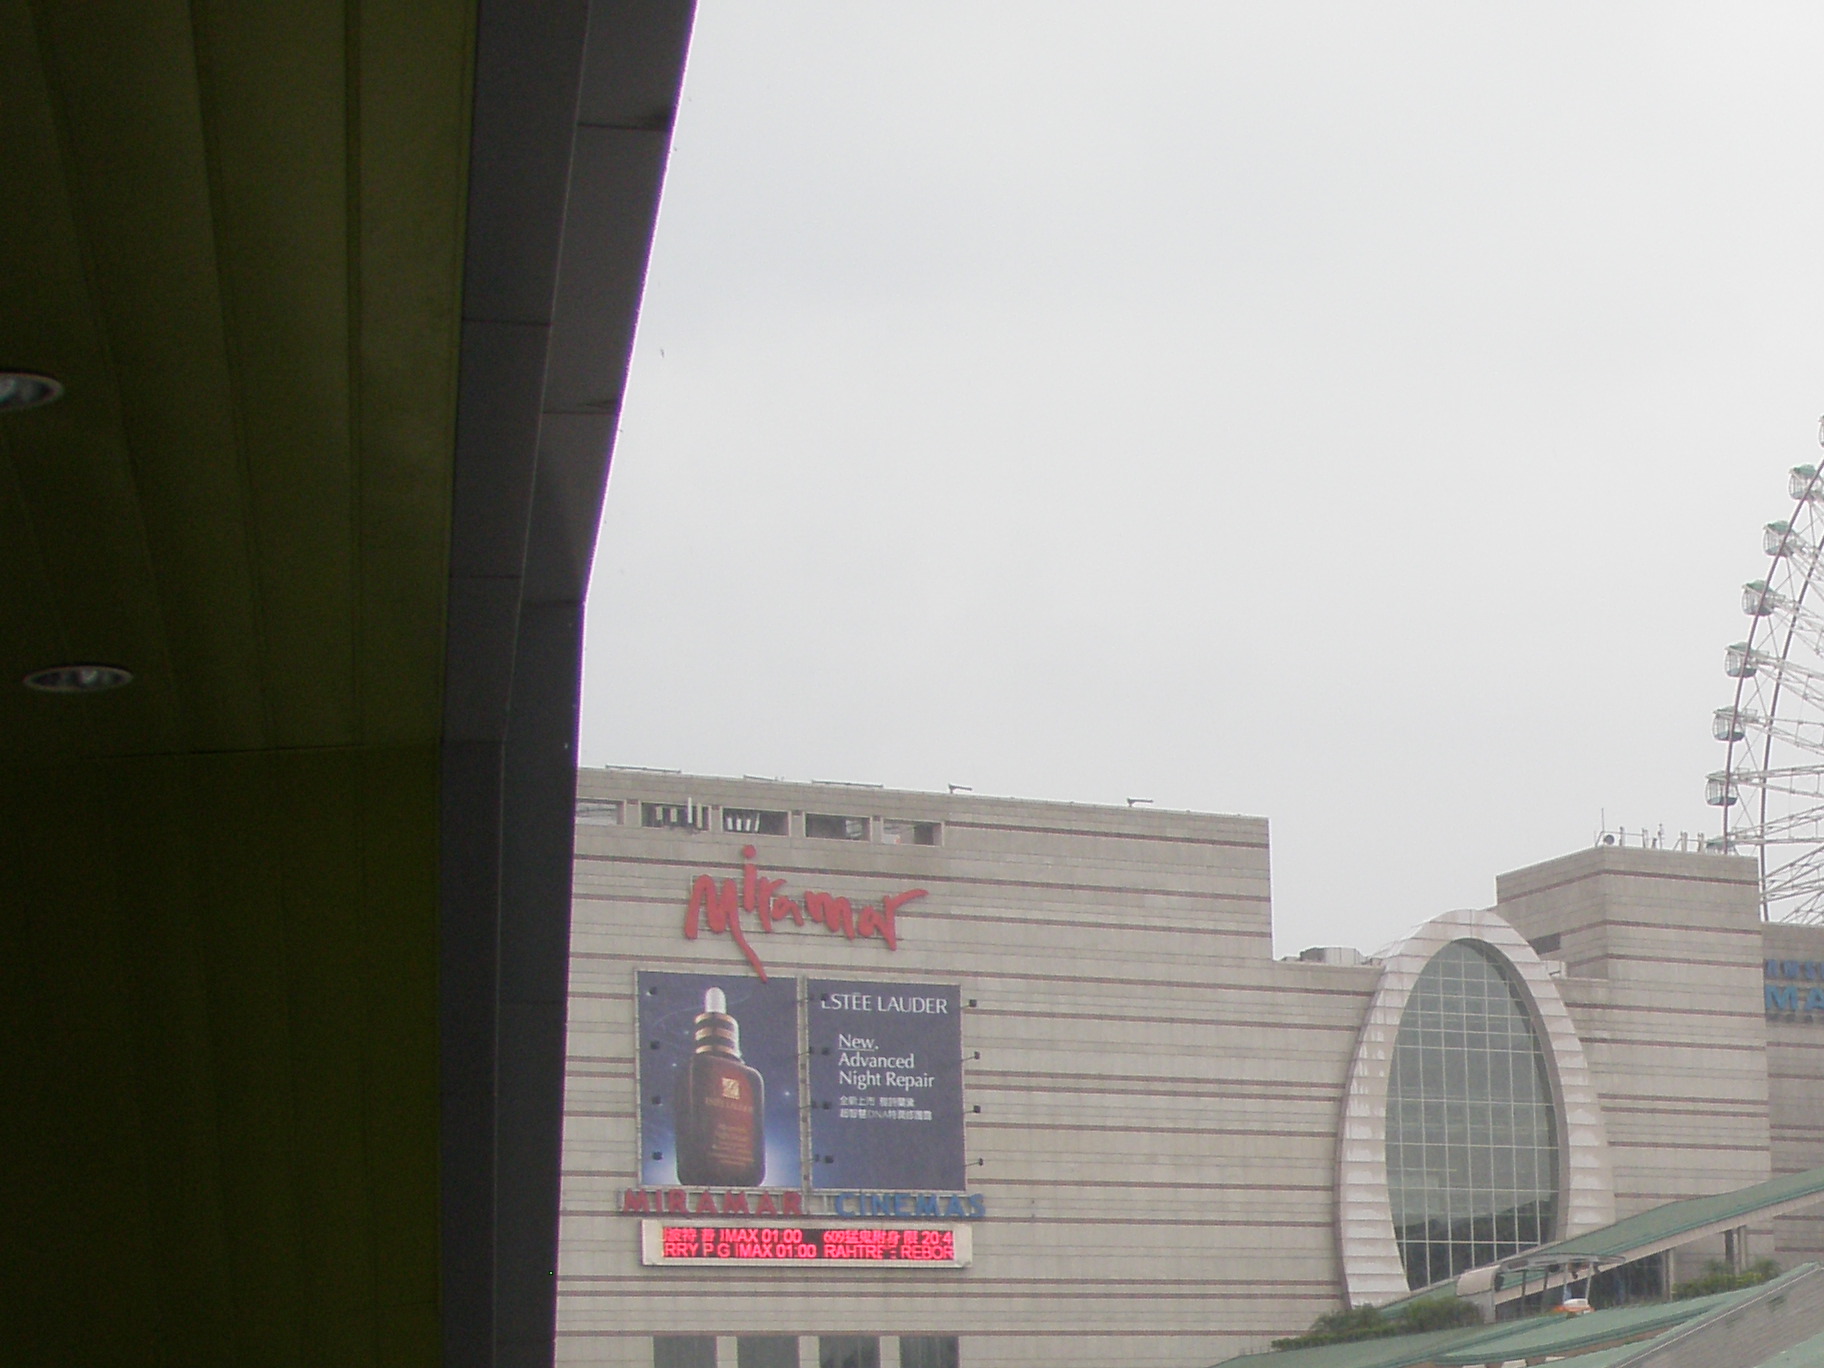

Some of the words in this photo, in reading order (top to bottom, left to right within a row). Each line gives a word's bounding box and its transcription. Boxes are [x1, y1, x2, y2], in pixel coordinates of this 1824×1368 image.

[684, 844, 929, 983] Miramar
[878, 995, 948, 1014] LAUDER
[838, 1033, 879, 1050] New.
[838, 1052, 915, 1069] Advanced
[839, 1070, 881, 1090] Night
[886, 1071, 935, 1091] Repair
[623, 1188, 802, 1216] MIRAMAR
[834, 1192, 986, 1218] CINEMAS
